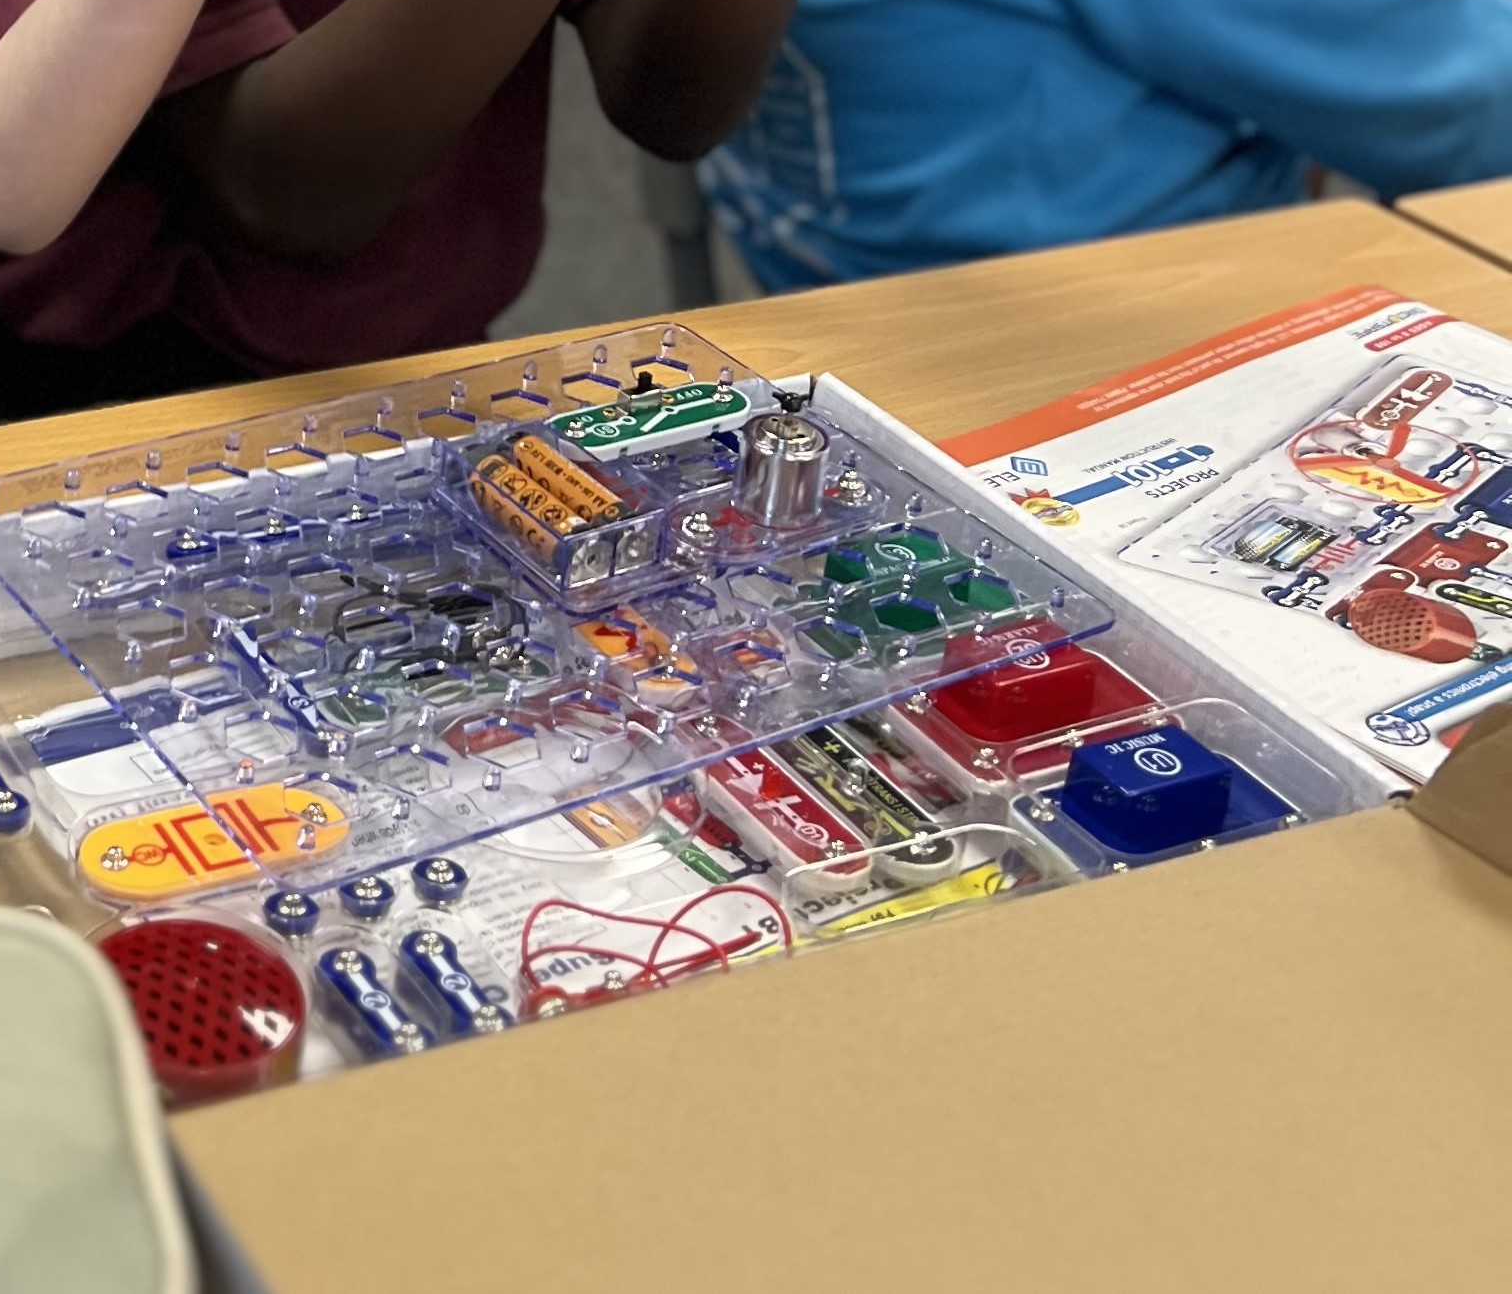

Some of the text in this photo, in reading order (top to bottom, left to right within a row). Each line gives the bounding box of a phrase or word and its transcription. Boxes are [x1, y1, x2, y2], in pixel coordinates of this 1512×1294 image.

[1082, 456, 1120, 474] MANUAL
[1145, 467, 1219, 500] PROJECTS
[1124, 732, 1167, 750] MUSIC
